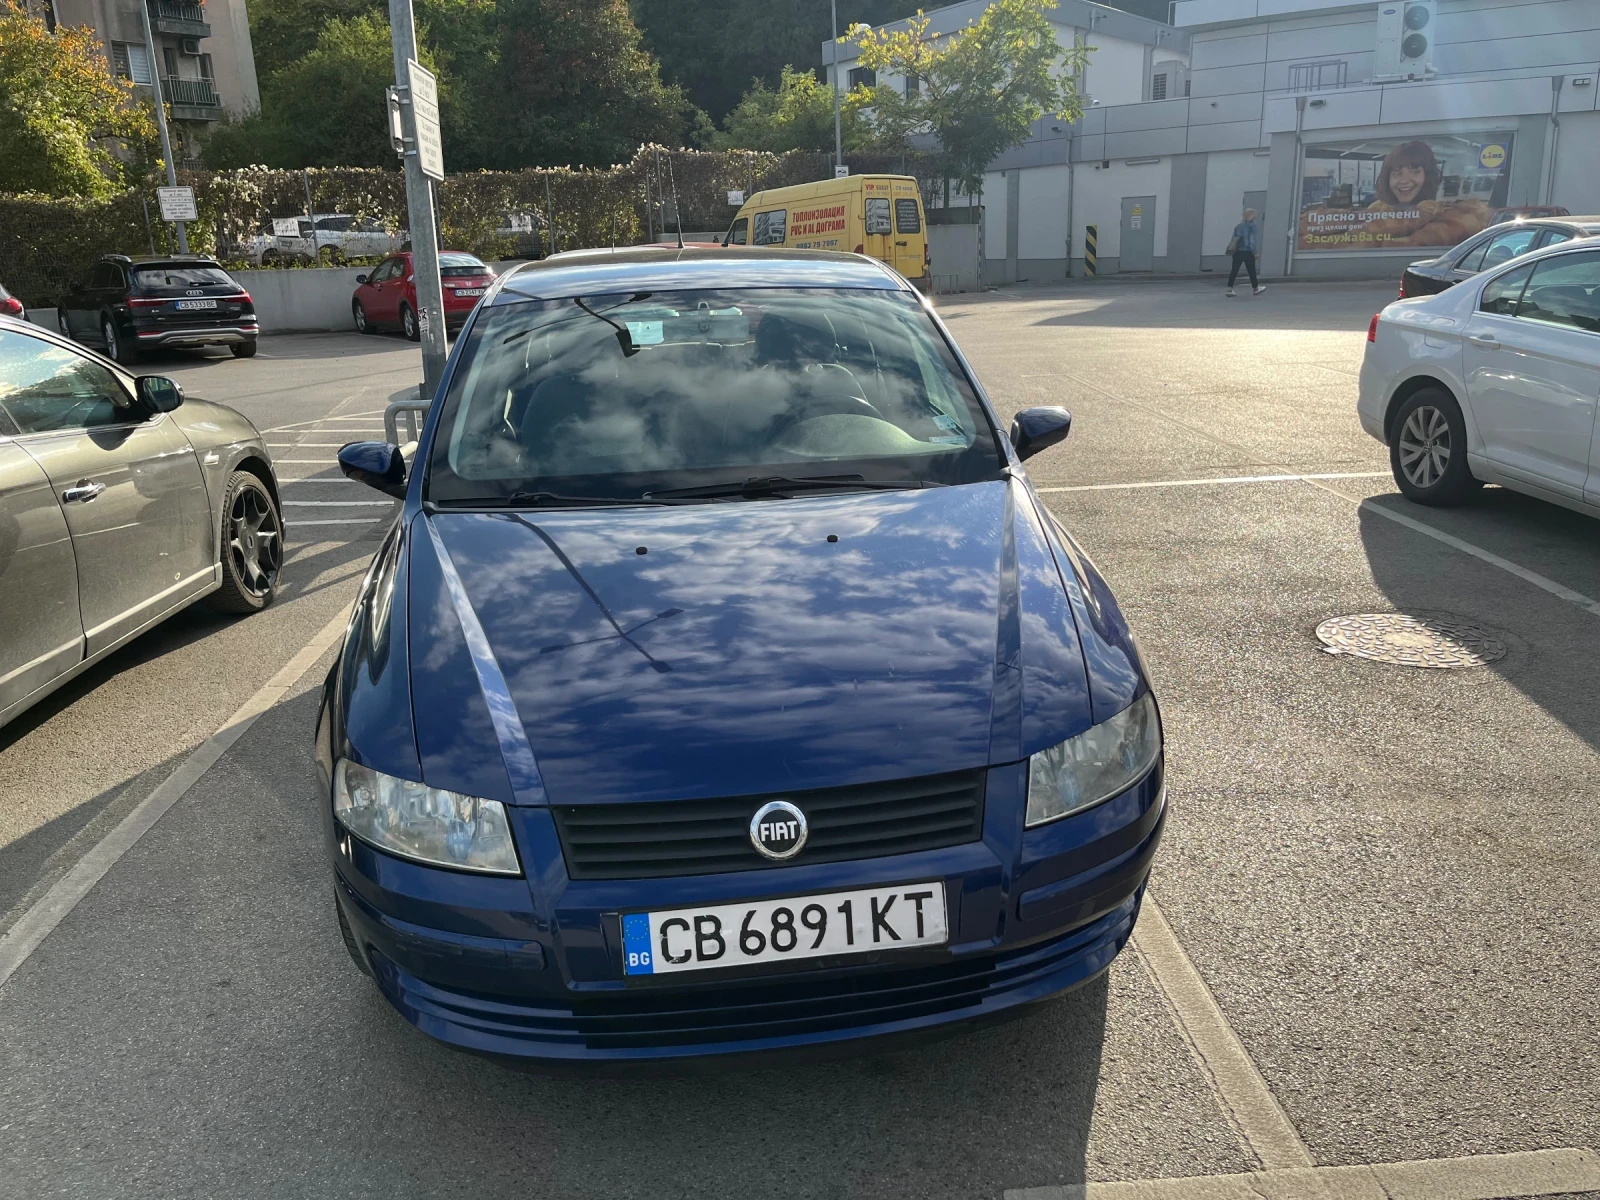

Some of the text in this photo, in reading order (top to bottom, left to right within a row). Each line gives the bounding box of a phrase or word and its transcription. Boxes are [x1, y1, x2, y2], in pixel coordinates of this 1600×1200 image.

[793, 206, 845, 222] ТОПЛОИЗОЛАЦИЯ
[1308, 210, 1420, 224] Прясно изпечени
[791, 225, 802, 236] PVC
[816, 220, 845, 234] ДОГРАМА
[1306, 231, 1394, 244] Заслужава си.
[760, 821, 798, 842] FIAT
[629, 891, 933, 967] BG CB 6891 KT
